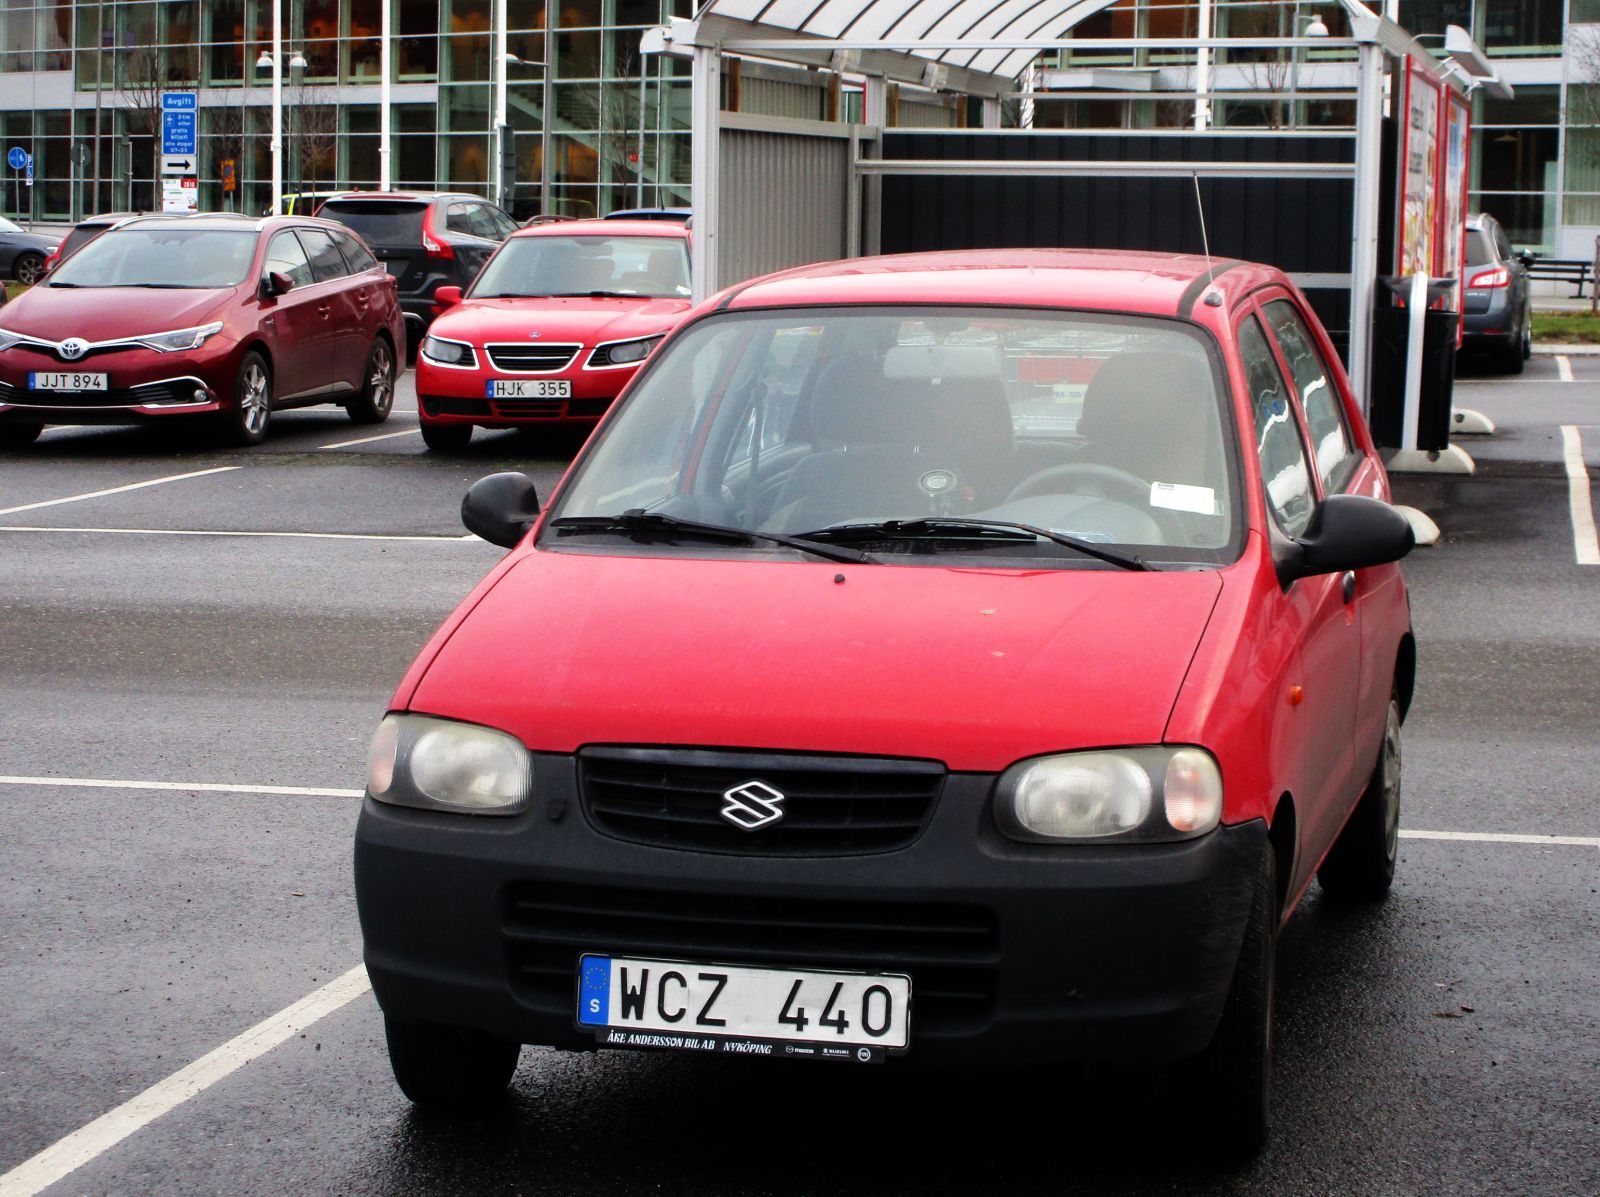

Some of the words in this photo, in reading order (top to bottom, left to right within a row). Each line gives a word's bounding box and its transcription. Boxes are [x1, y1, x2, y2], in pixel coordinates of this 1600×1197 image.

[168, 97, 192, 106] Avgift
[42, 374, 68, 388] JJT
[73, 375, 101, 388] 894
[496, 382, 524, 396] HJK
[538, 382, 568, 396] 355
[590, 999, 600, 1013] S
[620, 966, 728, 1027] WCZ
[778, 979, 892, 1037] 440
[606, 1029, 627, 1044] ÅKE
[628, 1033, 684, 1048] ANDERSSON
[684, 1038, 700, 1049] BIL
[701, 1040, 716, 1050] AB
[723, 1041, 773, 1054] NYKÖPING
